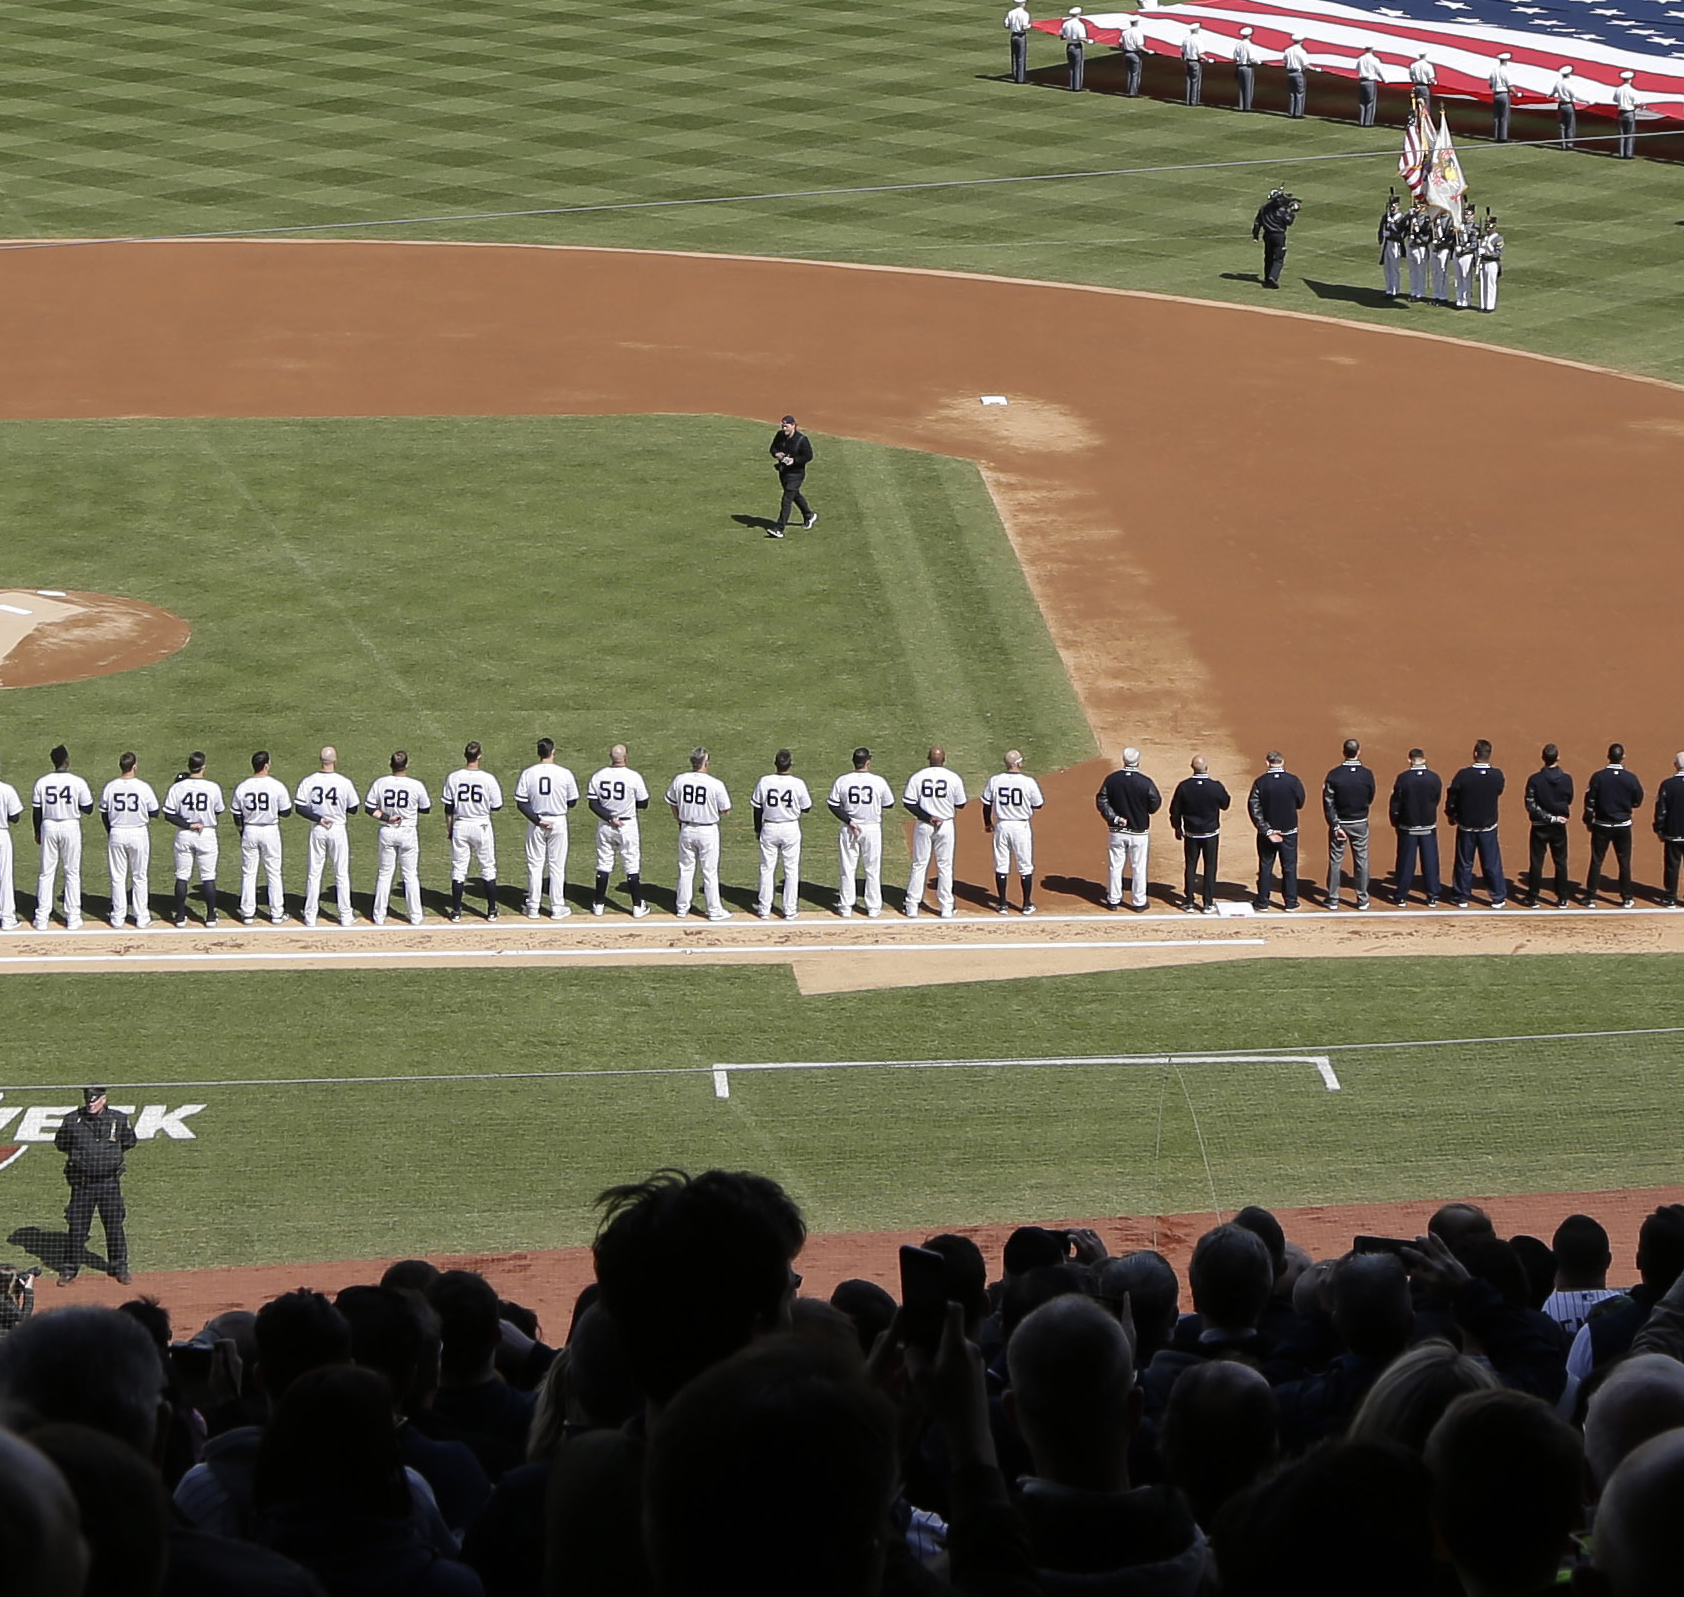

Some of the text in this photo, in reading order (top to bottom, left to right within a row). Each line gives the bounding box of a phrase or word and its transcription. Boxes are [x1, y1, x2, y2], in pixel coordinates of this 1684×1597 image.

[44, 785, 72, 805] 54
[311, 786, 338, 806] 34
[457, 783, 484, 803] 26
[538, 776, 551, 796] 0
[599, 780, 626, 801] 59
[682, 784, 707, 805] 88
[848, 785, 874, 805] 63
[921, 778, 948, 798] 62
[112, 792, 140, 812] 53
[181, 792, 209, 812] 48
[244, 792, 270, 811] 39
[383, 789, 409, 809] 28
[766, 788, 793, 809] 64
[998, 787, 1023, 806] 50
